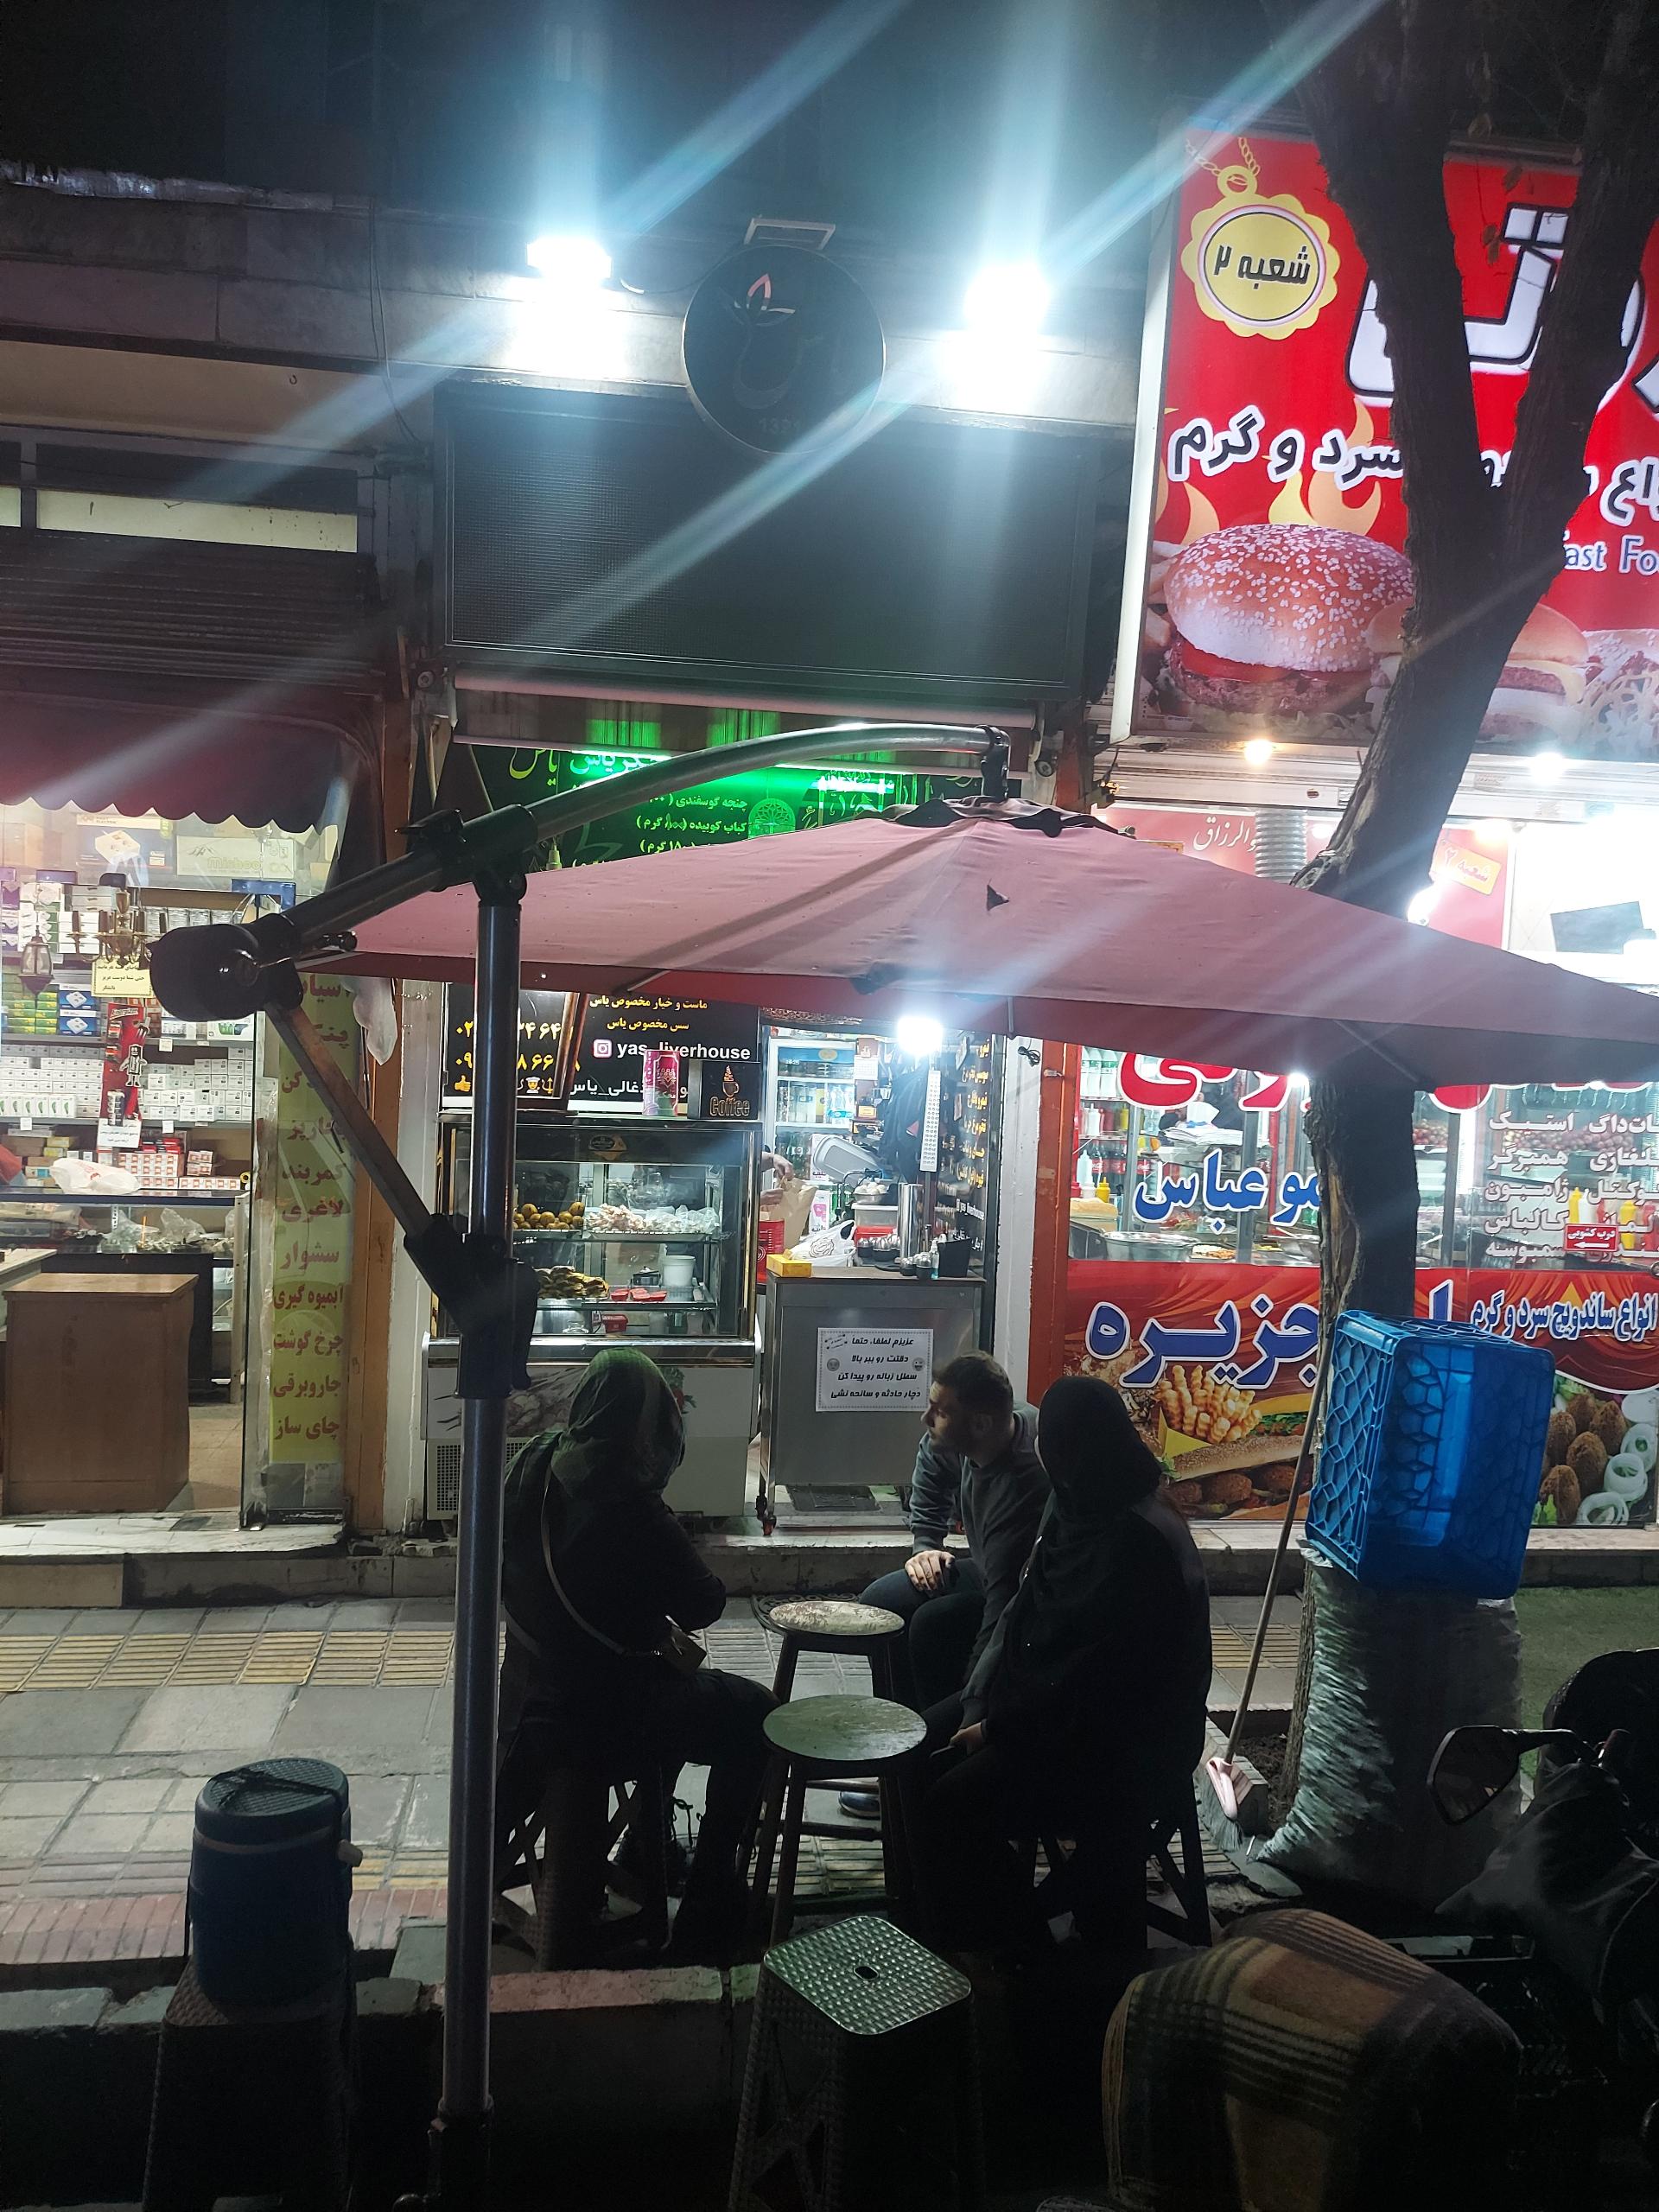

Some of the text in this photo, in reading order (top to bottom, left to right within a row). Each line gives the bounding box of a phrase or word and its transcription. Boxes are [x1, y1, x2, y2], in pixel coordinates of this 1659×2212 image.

[1237, 245, 1311, 290] شعبه
[1172, 410, 1402, 485] سرد و گرم
[1560, 537, 1659, 574] ast Fo
[689, 820, 722, 834] کوبیده
[723, 822, 747, 835] کباب
[589, 995, 610, 1007] یاس
[611, 996, 651, 1010] مخصوص
[652, 996, 673, 1011] خیار
[682, 999, 708, 1009] ماست
[607, 1016, 690, 1033] سس مخصوص یاس
[617, 1040, 752, 1060] yasliverhouse
[709, 1096, 751, 1117] Coffee
[1489, 1111, 1574, 1135] استیک
[1487, 1145, 1659, 1173] همبرگر لغاری
[1135, 1148, 1268, 1235] عباس
[1484, 1176, 1659, 1206] ژامبون وکتل
[1484, 1207, 1571, 1236] کالباس
[1596, 1230, 1617, 1241] درب
[279, 1241, 340, 1270] سشوار
[1484, 1240, 1567, 1264] سمبوسه
[1471, 1290, 1658, 1341] انواع ساندویچ سرد و گرم
[273, 1329, 345, 1357] چرخ گوشت
[892, 1338, 914, 1349] عزیزم
[887, 1355, 909, 1363] دقتت
[837, 1372, 849, 1381] کن
[849, 1372, 864, 1382] پیدا
[876, 1372, 893, 1381] زباله
[896, 1372, 917, 1381] سطل
[830, 1389, 849, 1399] نشی
[881, 1389, 903, 1397] حادثه
[903, 1390, 921, 1401] دچار
[274, 1415, 340, 1440] چای ساز
